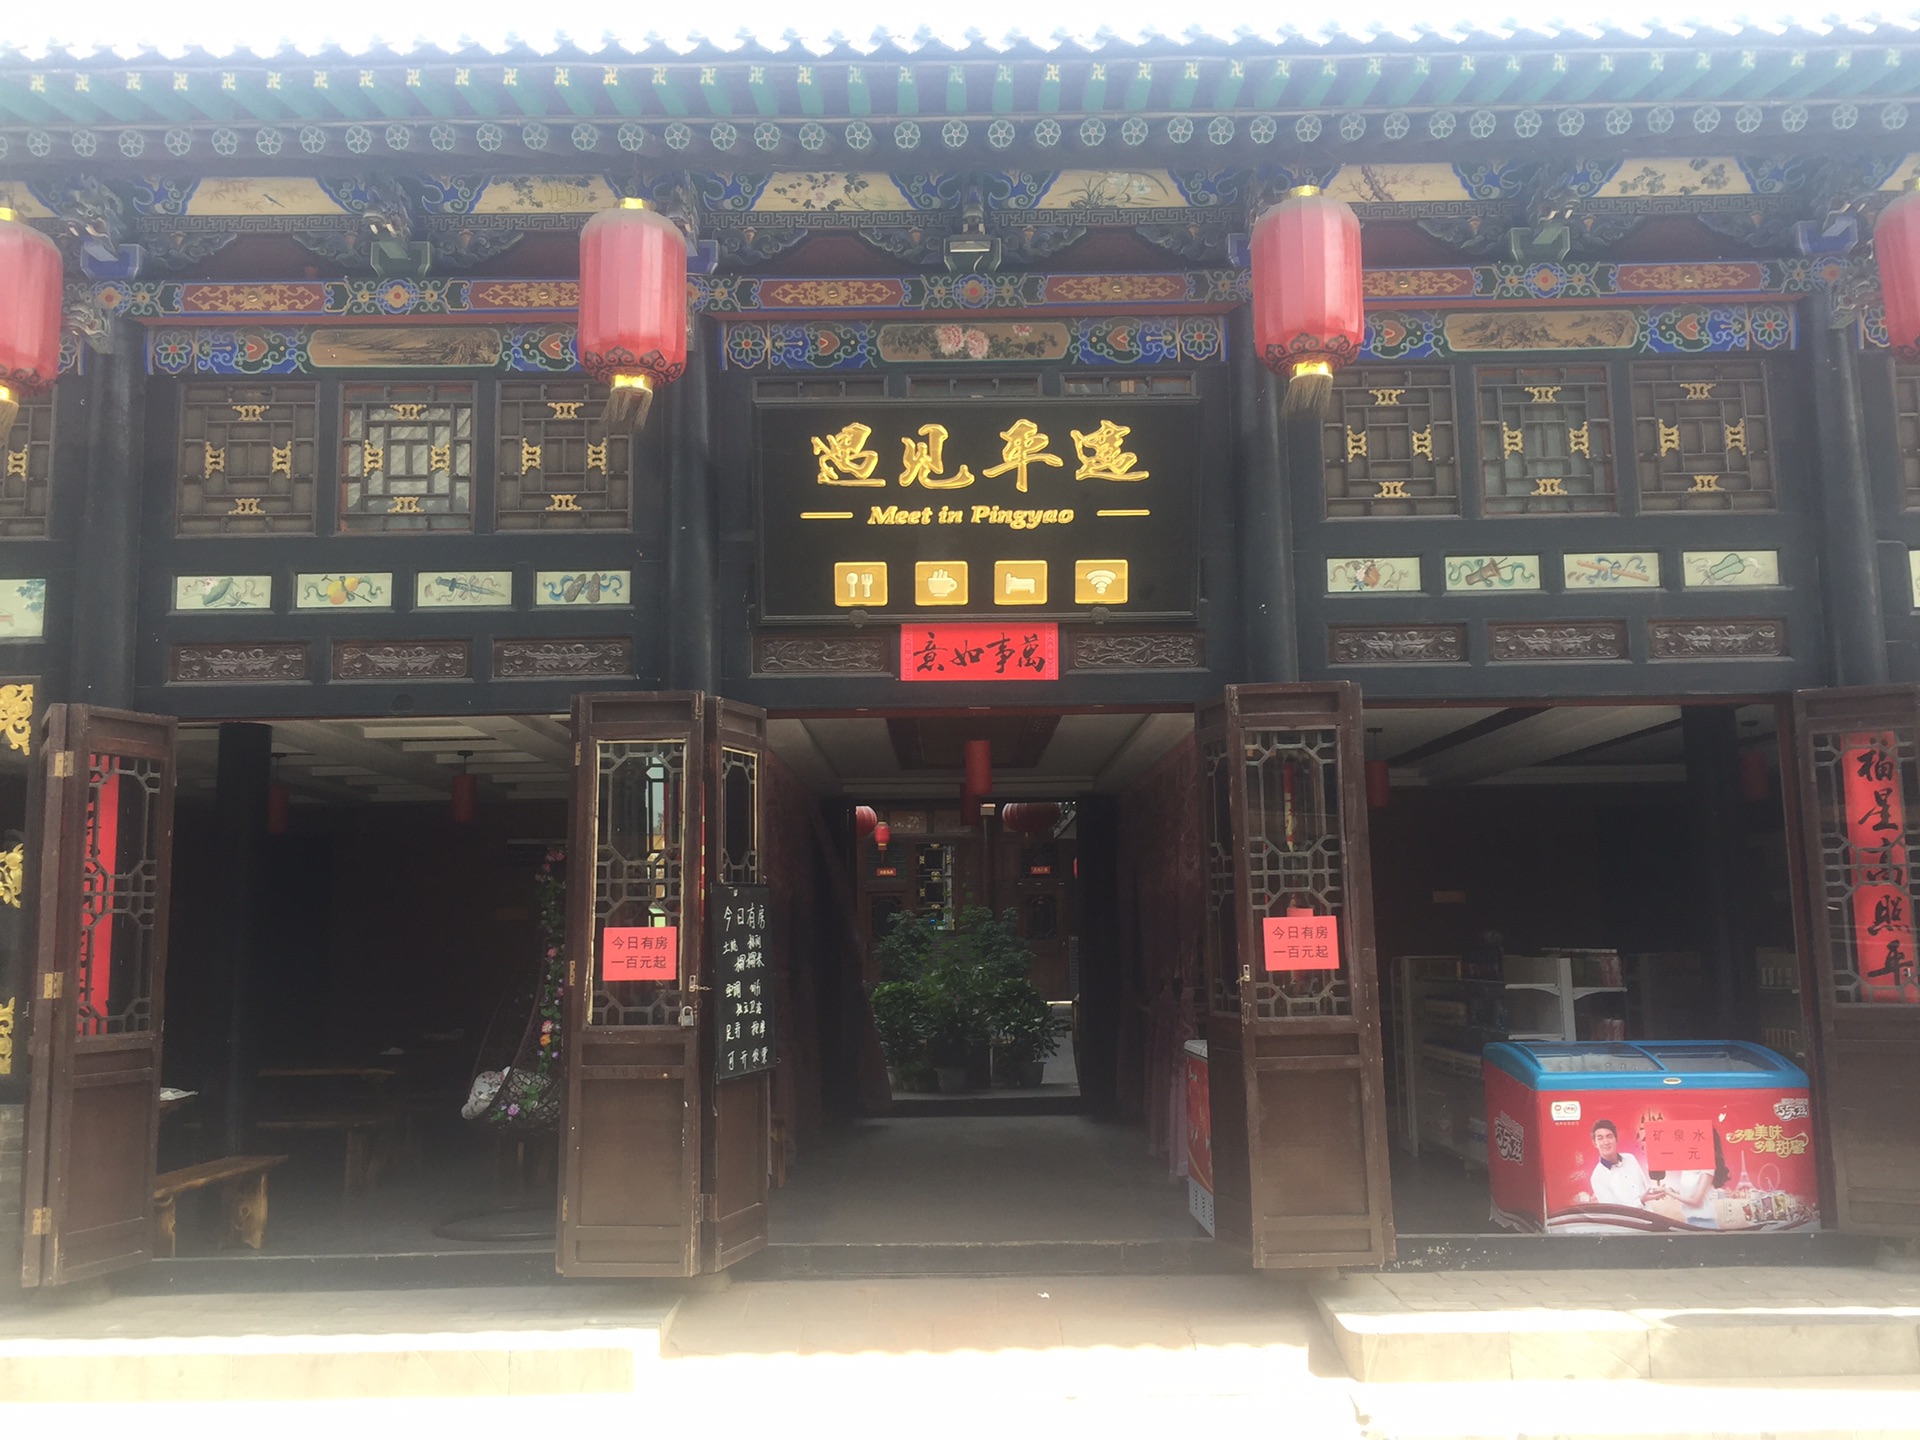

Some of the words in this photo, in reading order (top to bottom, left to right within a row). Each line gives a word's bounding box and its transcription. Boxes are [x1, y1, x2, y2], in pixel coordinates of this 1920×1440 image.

[811, 418, 1150, 492] 遇见平遥
[867, 505, 933, 526] Meet
[937, 505, 963, 525] in
[970, 505, 1075, 530] Pingyao
[723, 902, 766, 931] 今日有房
[1272, 925, 1328, 940] 今日有房
[611, 935, 669, 950] 今日有房
[1273, 945, 1329, 958] 一百元起
[611, 955, 667, 969] 一百元起
[1774, 1103, 1809, 1121] 巧乐兹
[1653, 1128, 1706, 1142] 矿泉水
[1661, 1147, 1700, 1160] 一元
